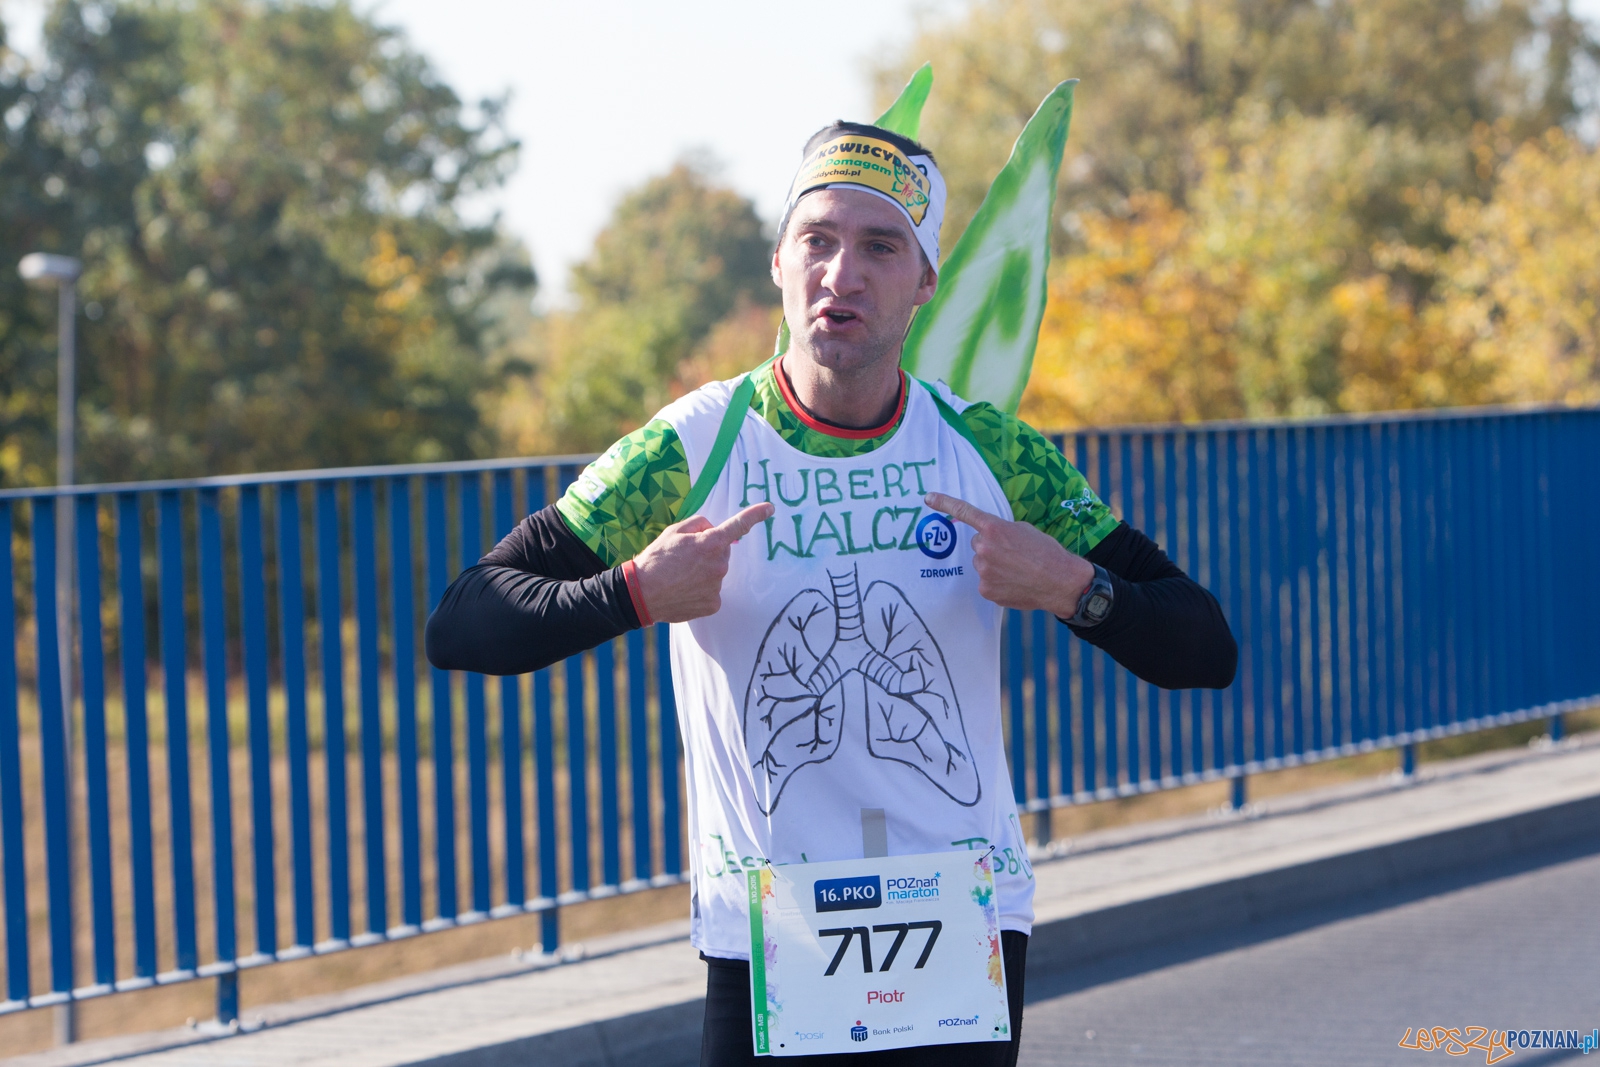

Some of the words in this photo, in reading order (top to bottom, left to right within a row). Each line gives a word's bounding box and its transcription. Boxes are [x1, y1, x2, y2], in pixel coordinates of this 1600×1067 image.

[739, 458, 936, 507] HUBERT
[764, 505, 930, 561] WALCZ
[925, 526, 949, 546] PZU
[920, 566, 964, 578] ZDROWIE
[819, 887, 840, 902] 16.
[843, 885, 876, 900] PKO
[887, 887, 939, 900] maraton
[818, 920, 943, 977] 7177
[867, 989, 905, 1004] Piotr
[873, 1028, 891, 1036] Bank
[893, 1024, 914, 1034] Polski
